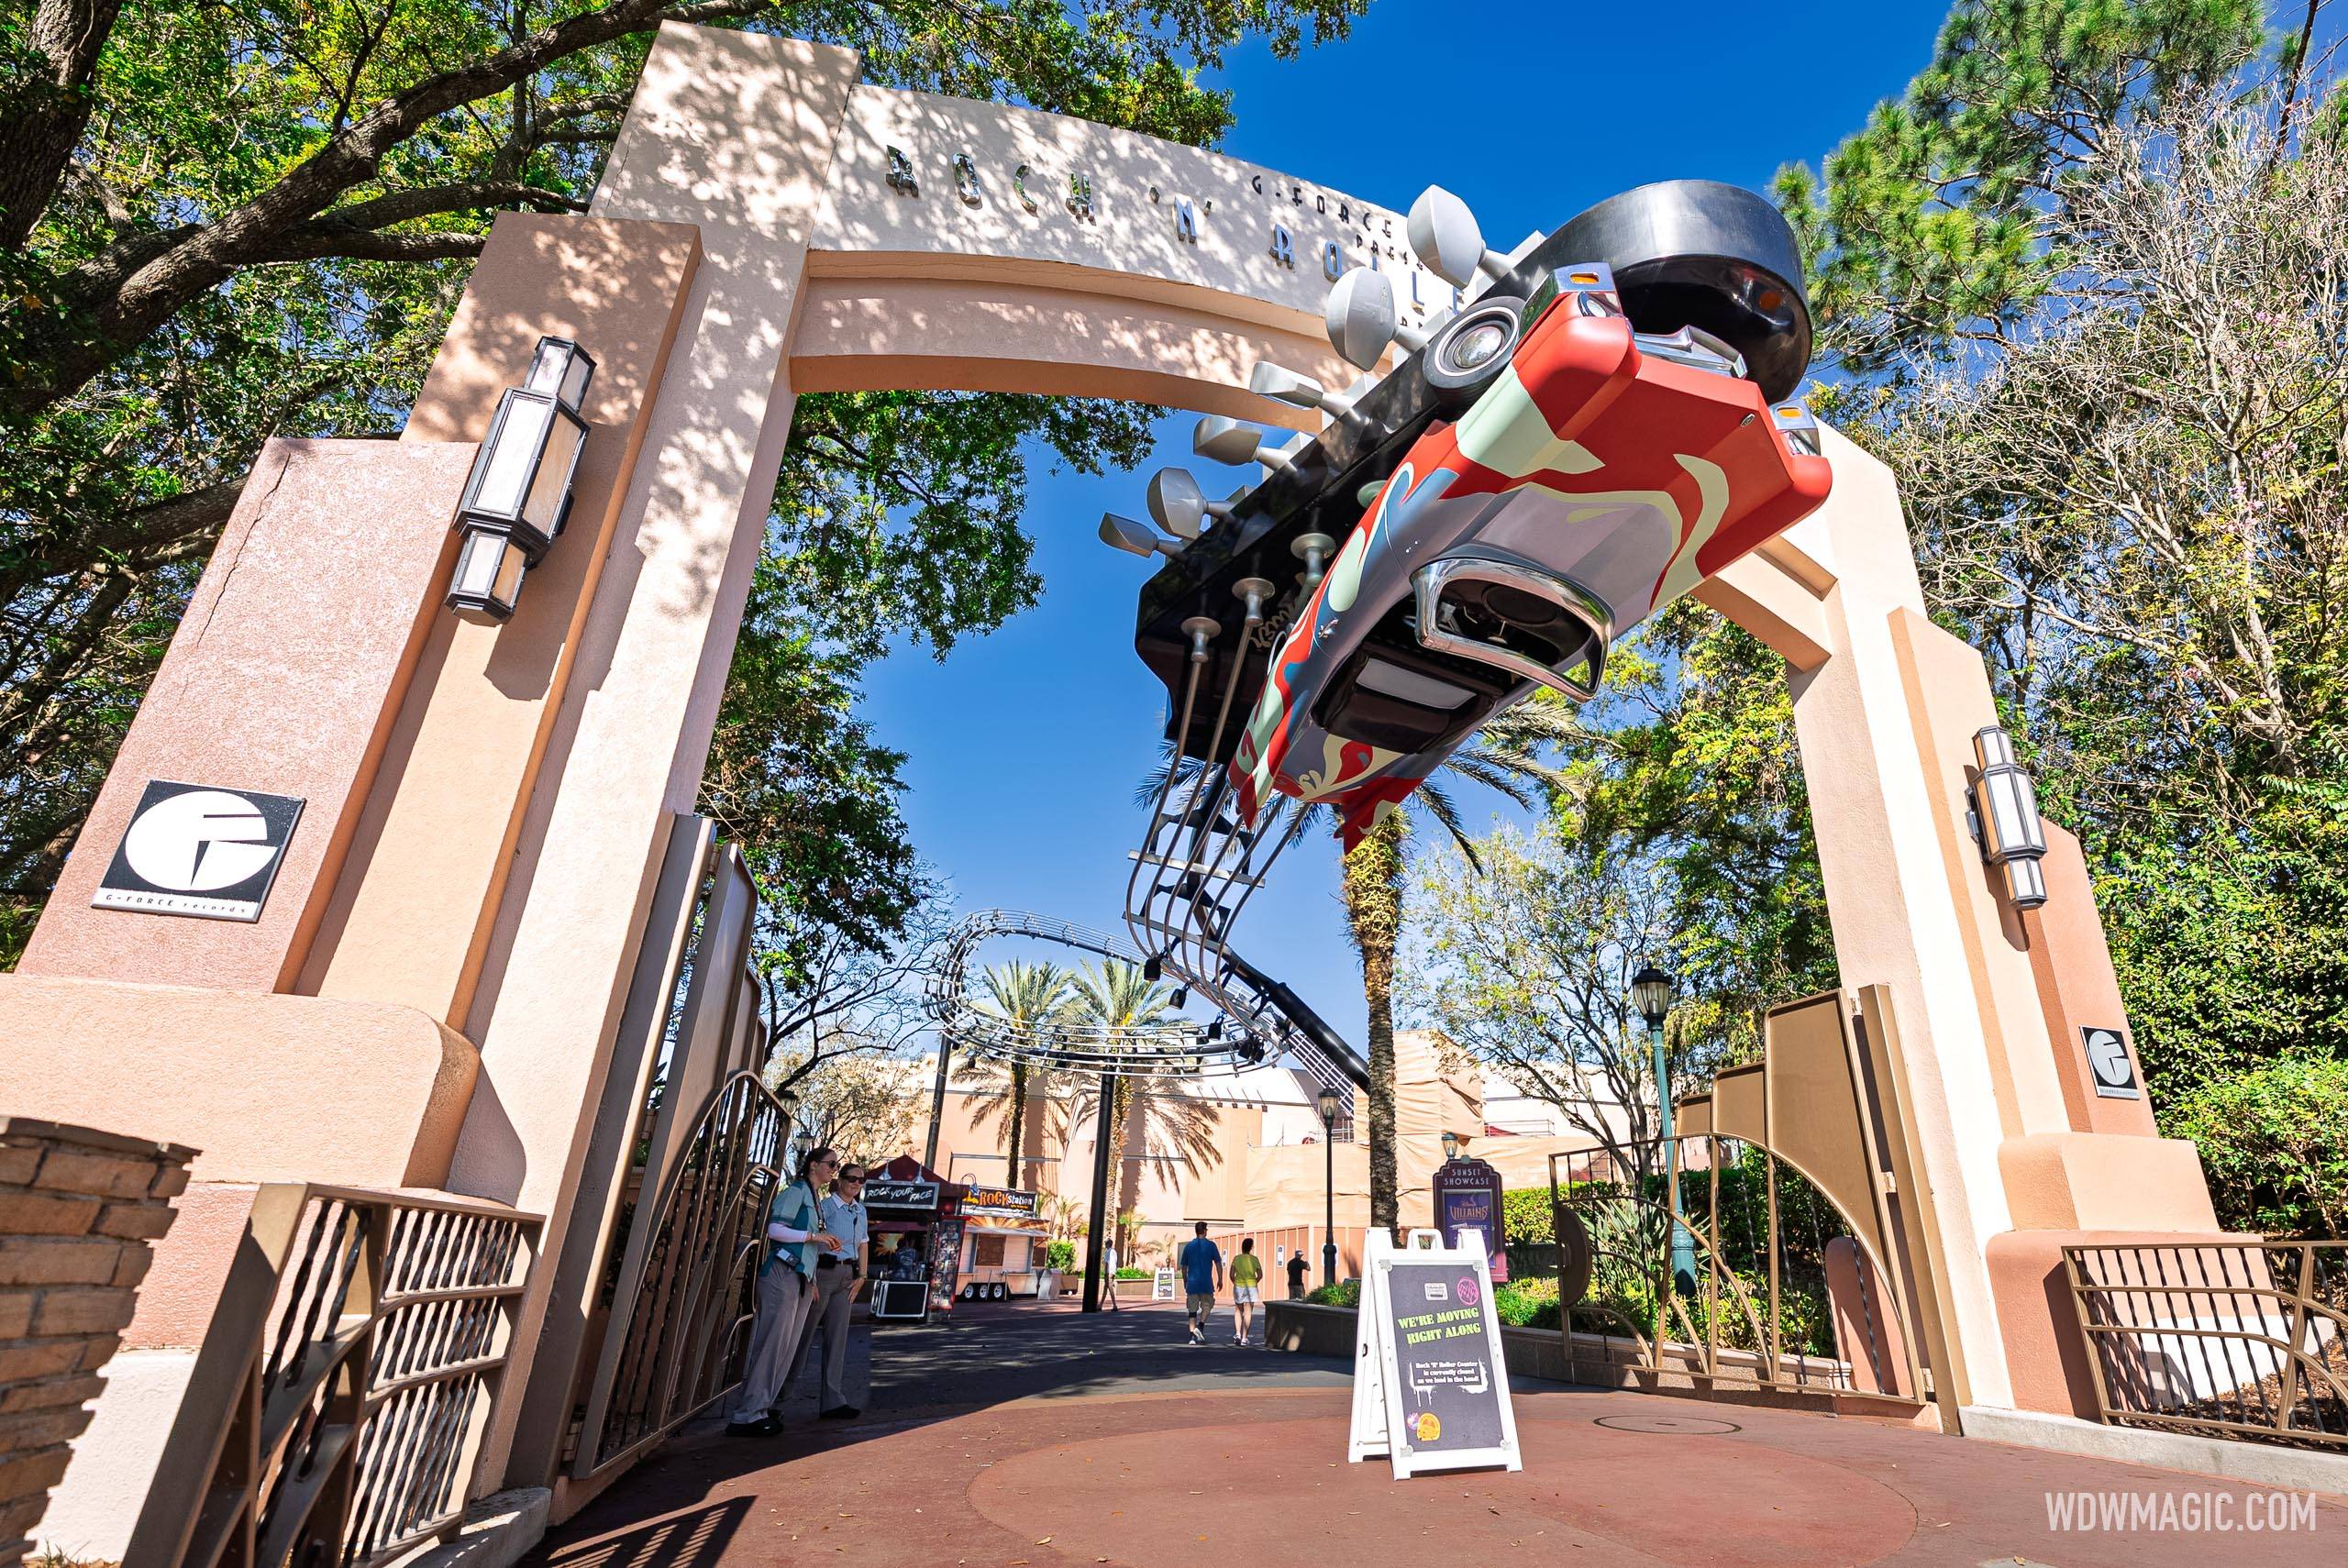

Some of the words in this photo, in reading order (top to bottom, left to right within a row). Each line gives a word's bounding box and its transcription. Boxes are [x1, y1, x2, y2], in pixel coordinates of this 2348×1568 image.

[885, 144, 1102, 226] ROCK
[105, 894, 174, 907] G-FORCE
[183, 902, 247, 913] records
[1452, 1168, 1481, 1176] SUNSET
[1444, 1177, 1490, 1186] SHOWCASE
[867, 1187, 892, 1198] ROCK
[891, 1187, 914, 1199] YOUR
[908, 1189, 933, 1202] FACE
[1450, 1205, 1489, 1221] VILLAINS
[1397, 1314, 1434, 1329] WE'RE
[1436, 1307, 1479, 1323] MOVING
[1406, 1329, 1442, 1344] RIGHT
[1445, 1323, 1481, 1338] ALONG
